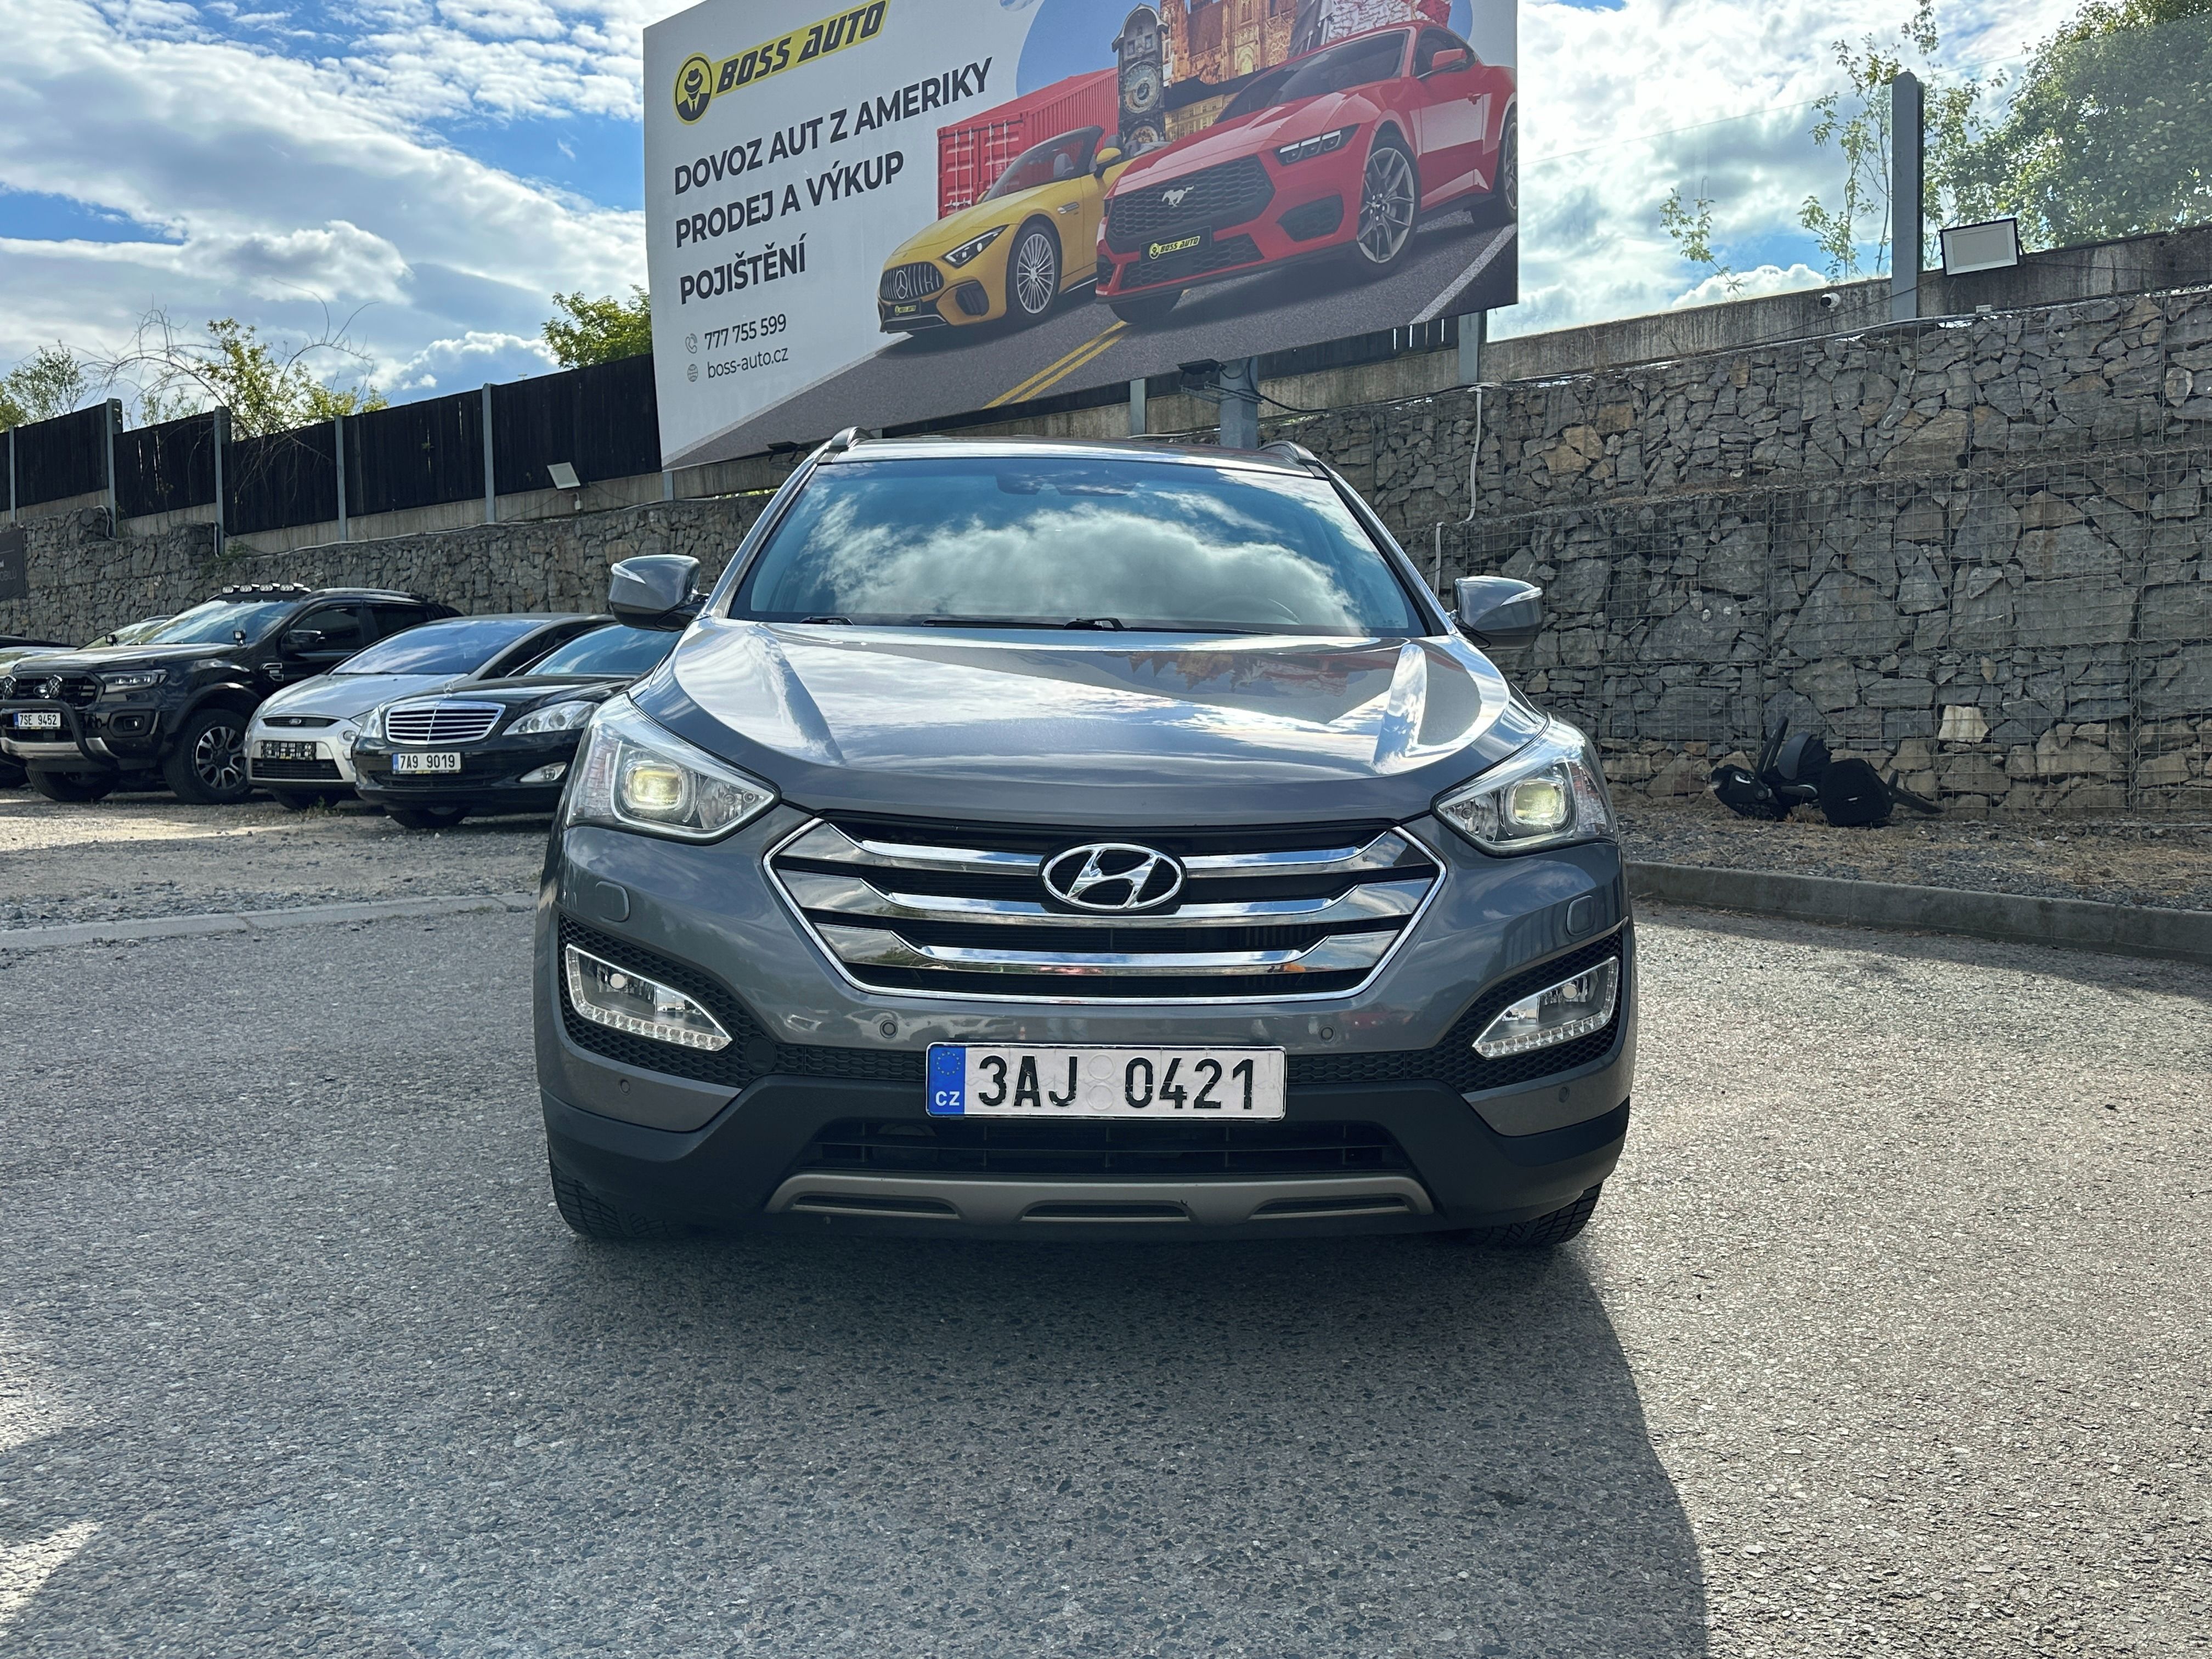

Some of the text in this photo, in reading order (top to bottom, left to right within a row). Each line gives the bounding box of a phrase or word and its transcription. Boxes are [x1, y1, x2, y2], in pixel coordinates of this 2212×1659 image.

[716, 1, 886, 94] BOSS AUTO
[675, 57, 992, 195] DOVOZ AUT Z AMERIKY
[676, 151, 904, 248] PRODEJ A VÝKUP
[1160, 238, 1199, 252] BOSS AUTO
[680, 233, 806, 304] POJIŠTĚNÍ
[704, 313, 787, 350] 777 755 599
[707, 347, 789, 379] boss-auto.cz
[20, 714, 57, 725] 7SE 9452
[400, 755, 418, 769] 7A9
[426, 754, 455, 768] 9019
[935, 1091, 960, 1107] CZ
[978, 1055, 1256, 1110] 3AJ 0421
